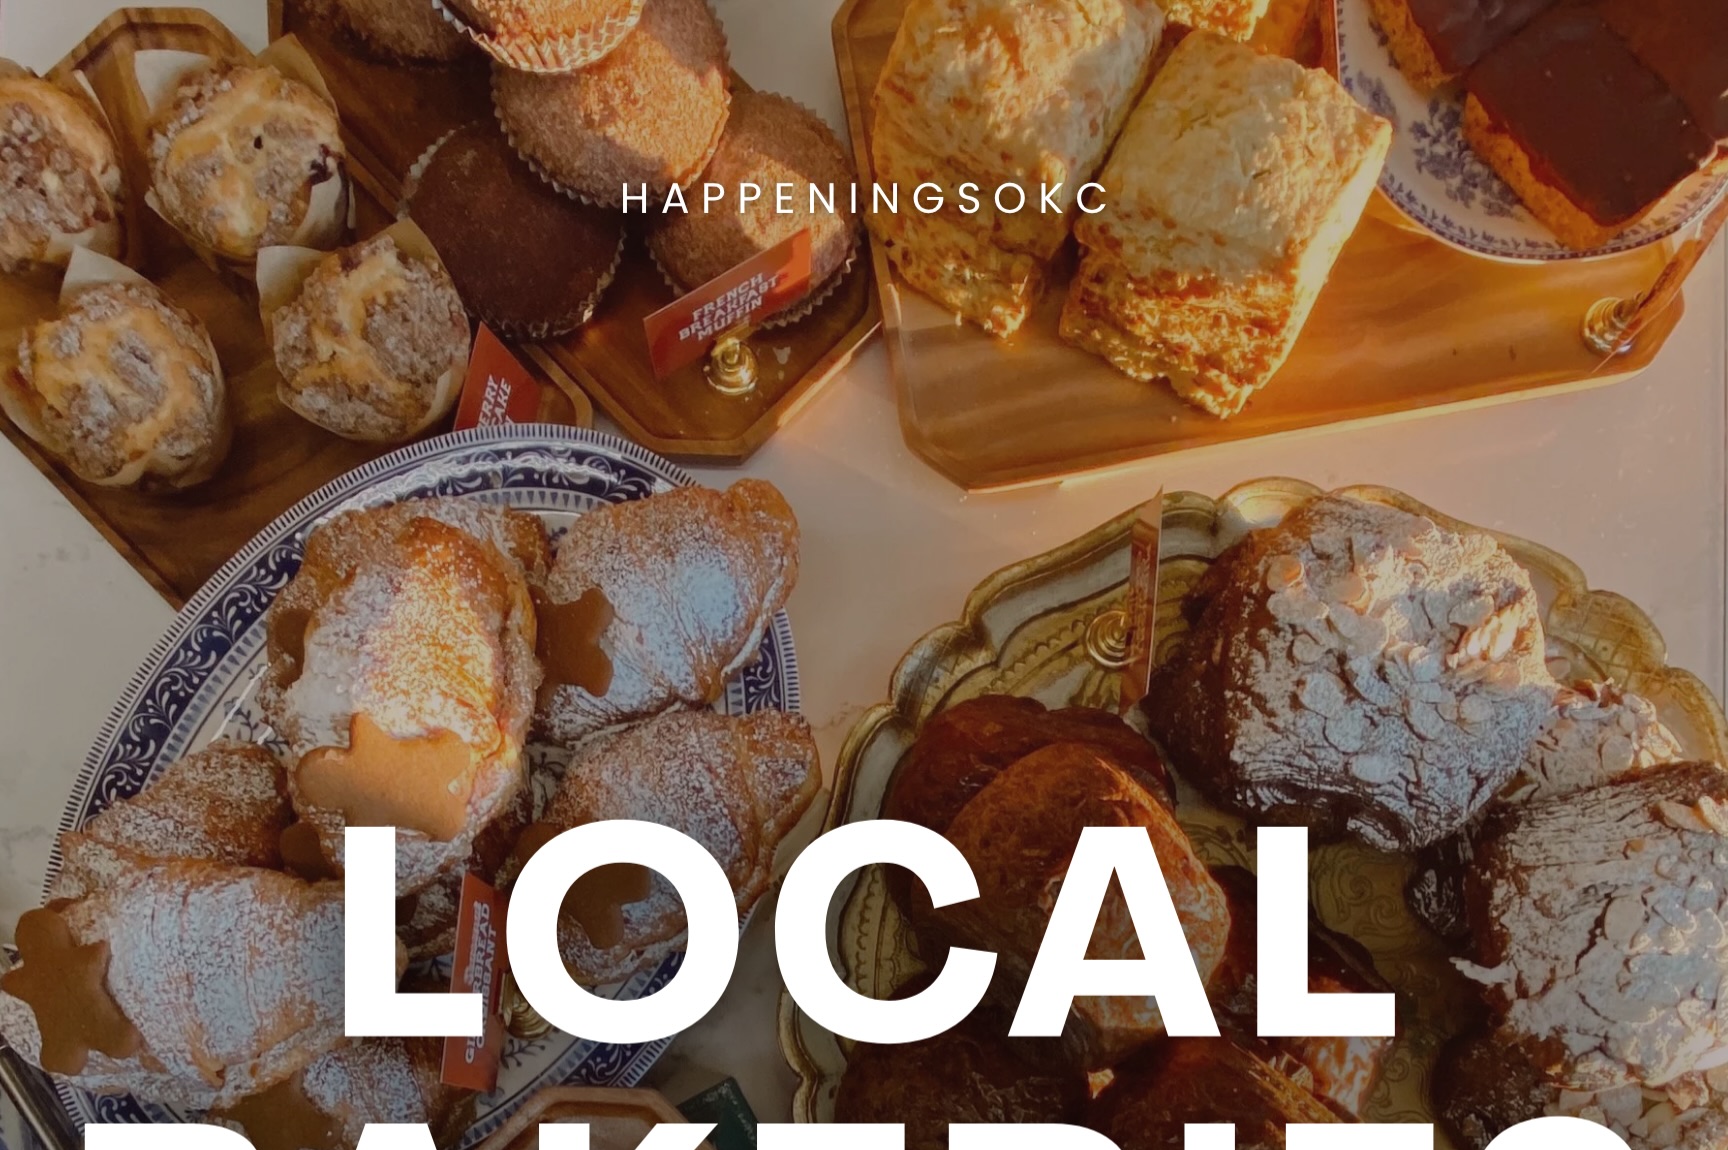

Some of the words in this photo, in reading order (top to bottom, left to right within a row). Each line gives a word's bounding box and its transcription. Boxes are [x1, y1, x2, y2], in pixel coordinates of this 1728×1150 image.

[678, 275, 779, 341] BREAKFAST
[692, 272, 763, 322] FRENCH
[697, 295, 763, 341] MUFFIN
[464, 902, 491, 1064] GIRBREAD
[476, 924, 497, 1049] CISSANT
